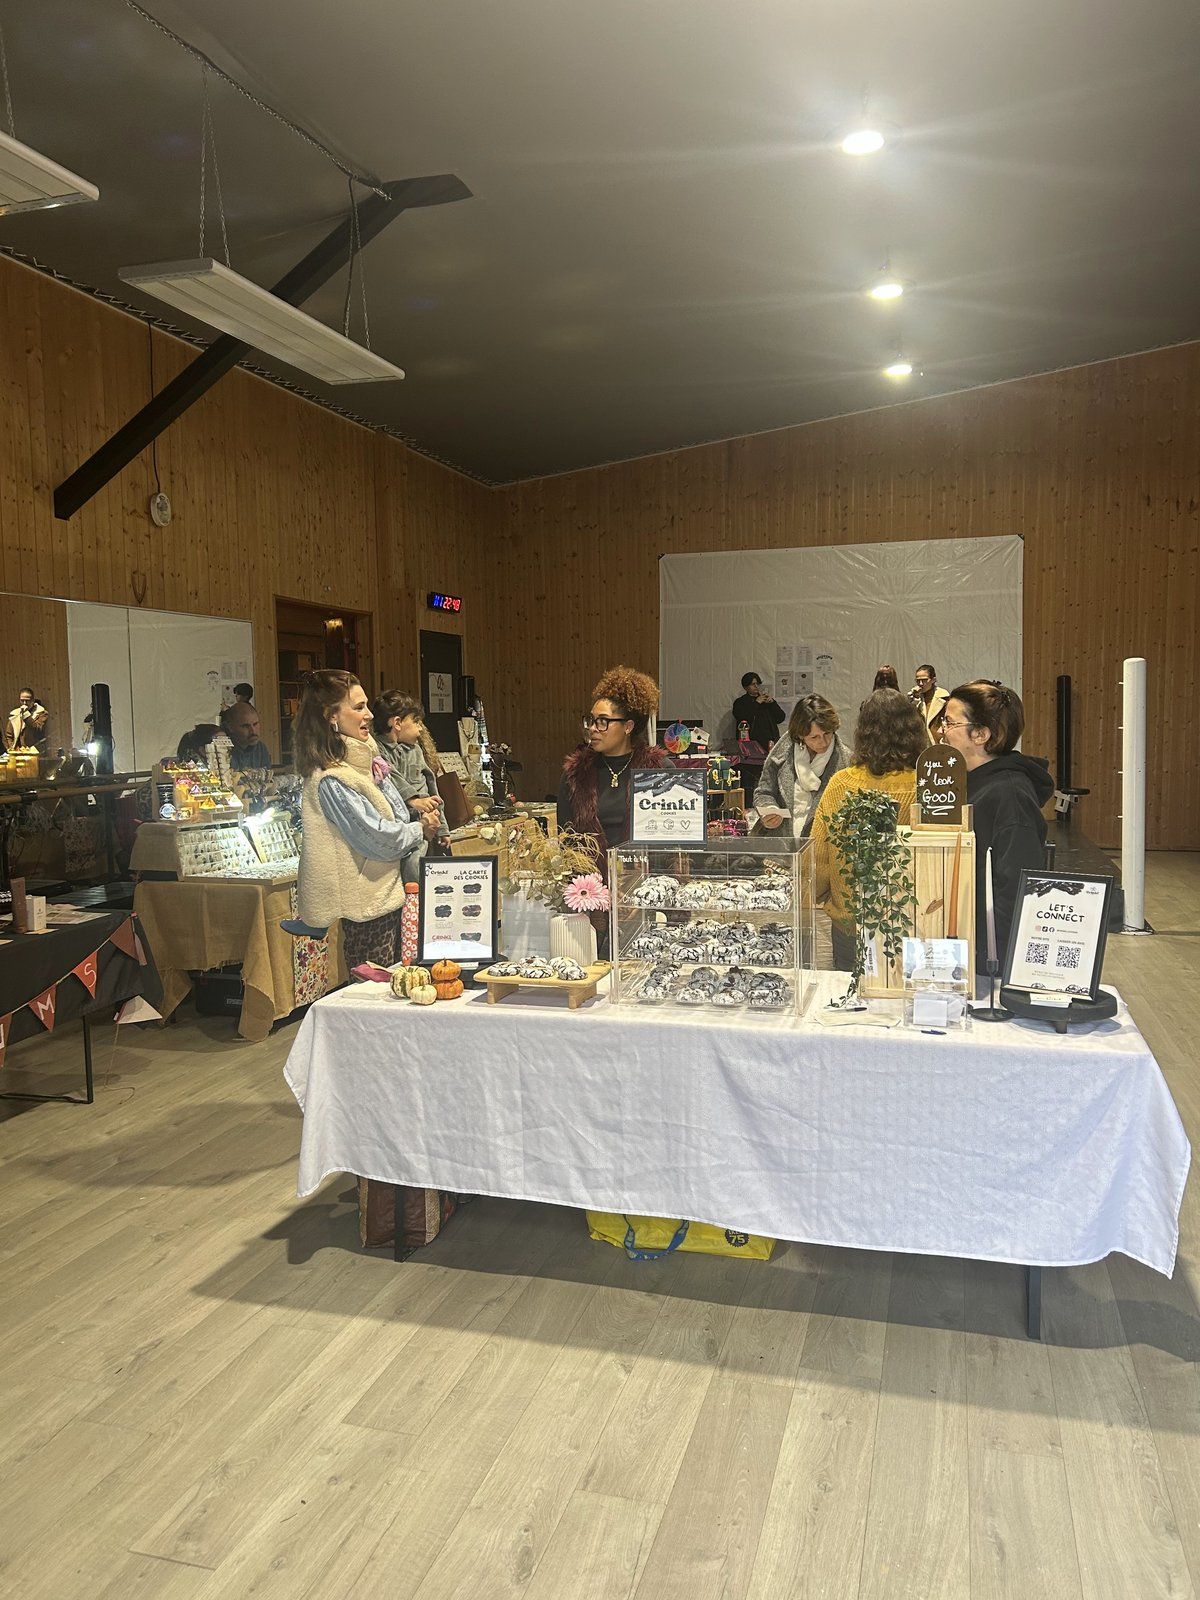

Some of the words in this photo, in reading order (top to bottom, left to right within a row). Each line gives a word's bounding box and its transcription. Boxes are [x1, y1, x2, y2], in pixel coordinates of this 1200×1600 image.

[933, 772, 955, 786] look
[922, 789, 956, 804] GOOD
[618, 855, 633, 863] Tout
[1049, 903, 1074, 913] LET'S
[1036, 911, 1085, 922] CONNECT
[729, 1235, 745, 1244] 75
